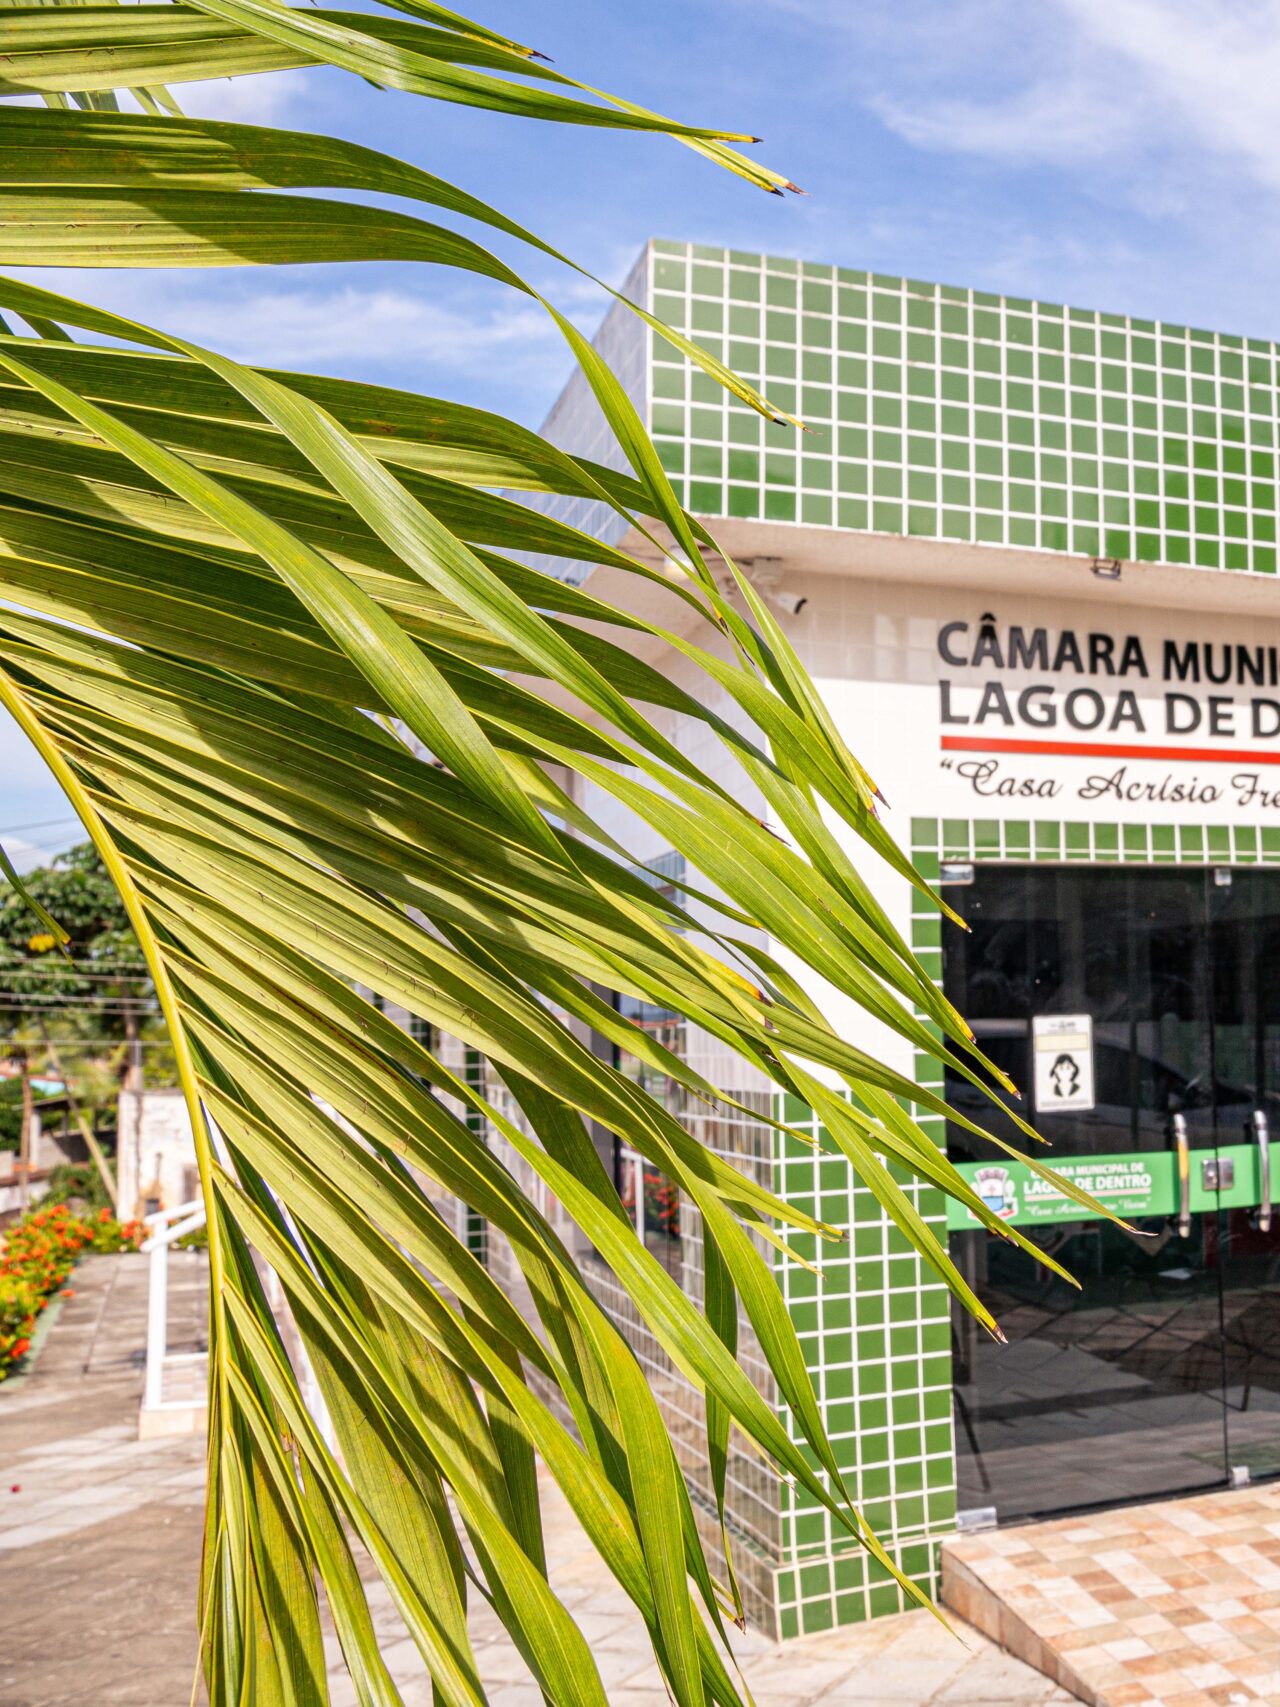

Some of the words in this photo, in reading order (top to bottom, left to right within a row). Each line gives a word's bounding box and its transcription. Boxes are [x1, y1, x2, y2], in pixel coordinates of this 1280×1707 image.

[937, 613, 1148, 678] CÂMARA
[939, 680, 1145, 733] LAGOA
[1166, 692, 1235, 737] DE
[1078, 766, 1223, 803] Acrísio
[1095, 1173, 1152, 1190] DENTRO
